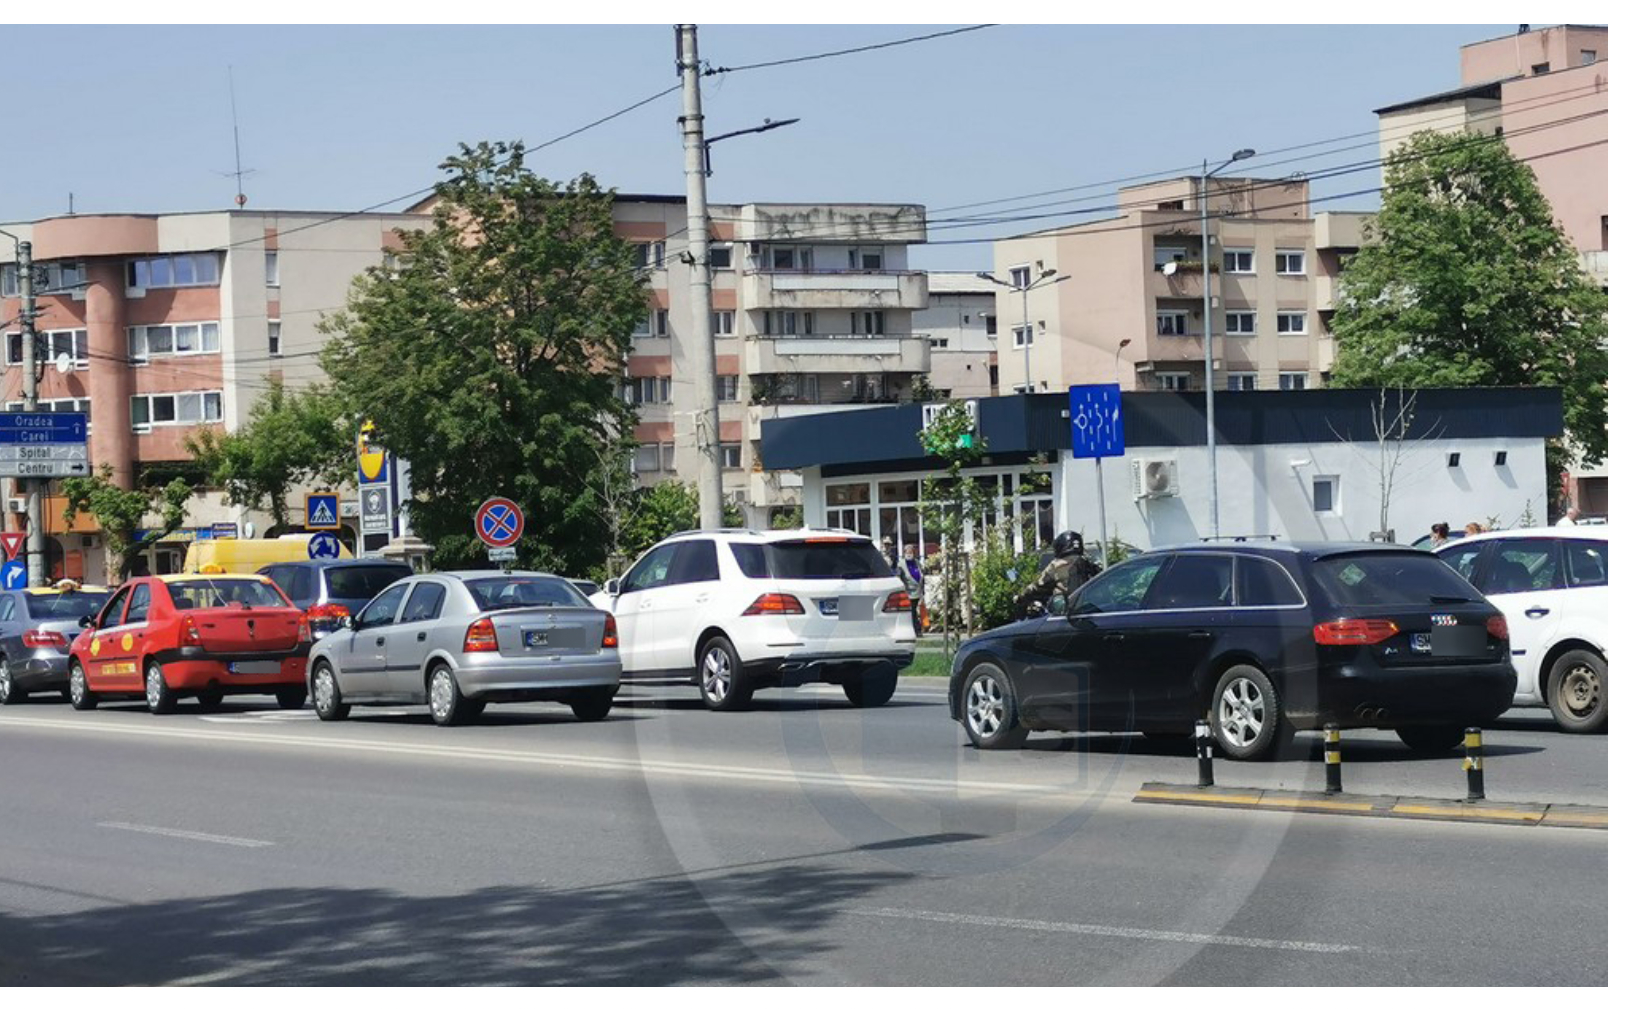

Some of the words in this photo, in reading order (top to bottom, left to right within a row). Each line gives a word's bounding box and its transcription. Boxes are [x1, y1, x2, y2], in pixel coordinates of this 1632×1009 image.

[15, 415, 53, 426] Oradea
[21, 431, 48, 441] Carei
[19, 447, 50, 459] Spital
[18, 463, 53, 474] Centru
